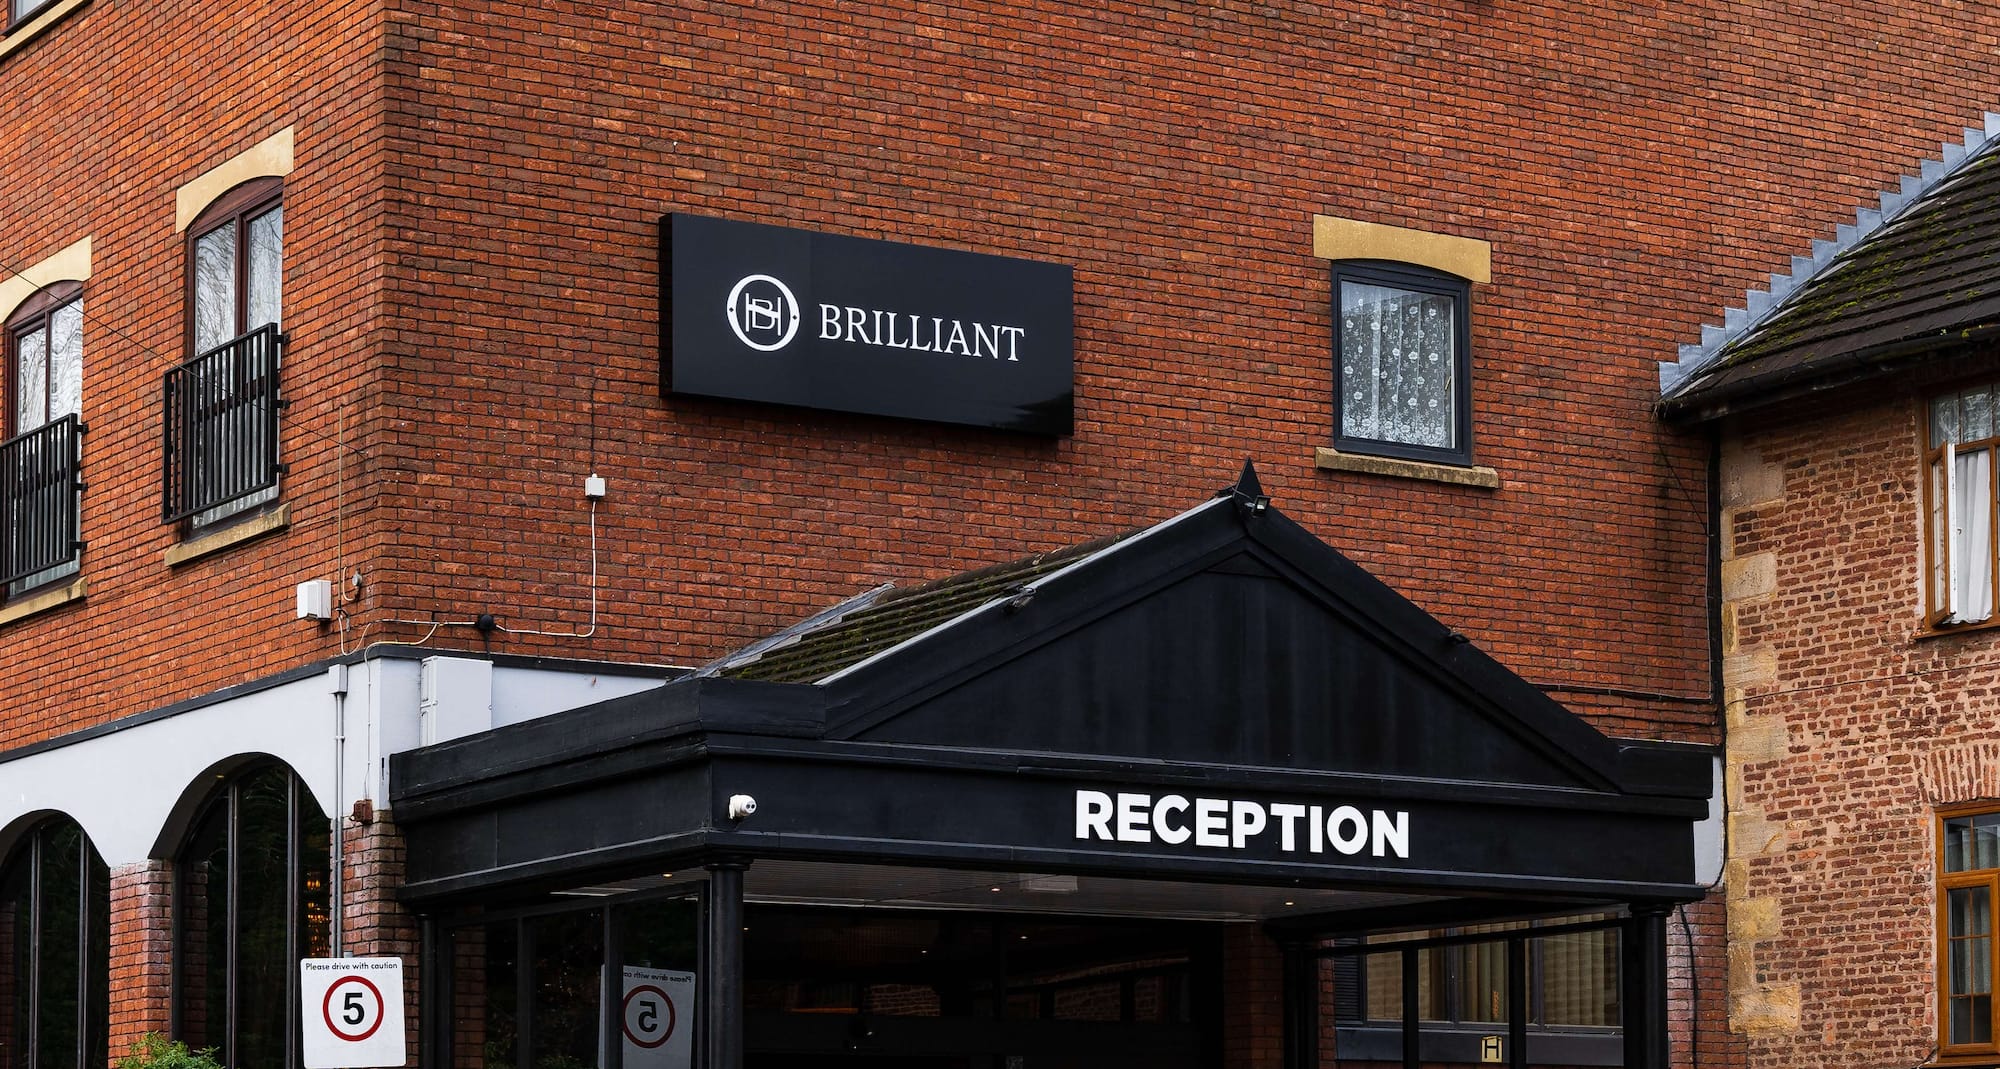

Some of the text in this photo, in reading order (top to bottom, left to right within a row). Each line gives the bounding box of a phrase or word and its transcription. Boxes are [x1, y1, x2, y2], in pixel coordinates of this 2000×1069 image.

[819, 303, 1025, 362] BRILLIANT
[1075, 789, 1410, 859] RECEPTION
[305, 961, 398, 971] Please drive with caution
[343, 992, 365, 1025] 5
[1484, 1039, 1499, 1058] H
